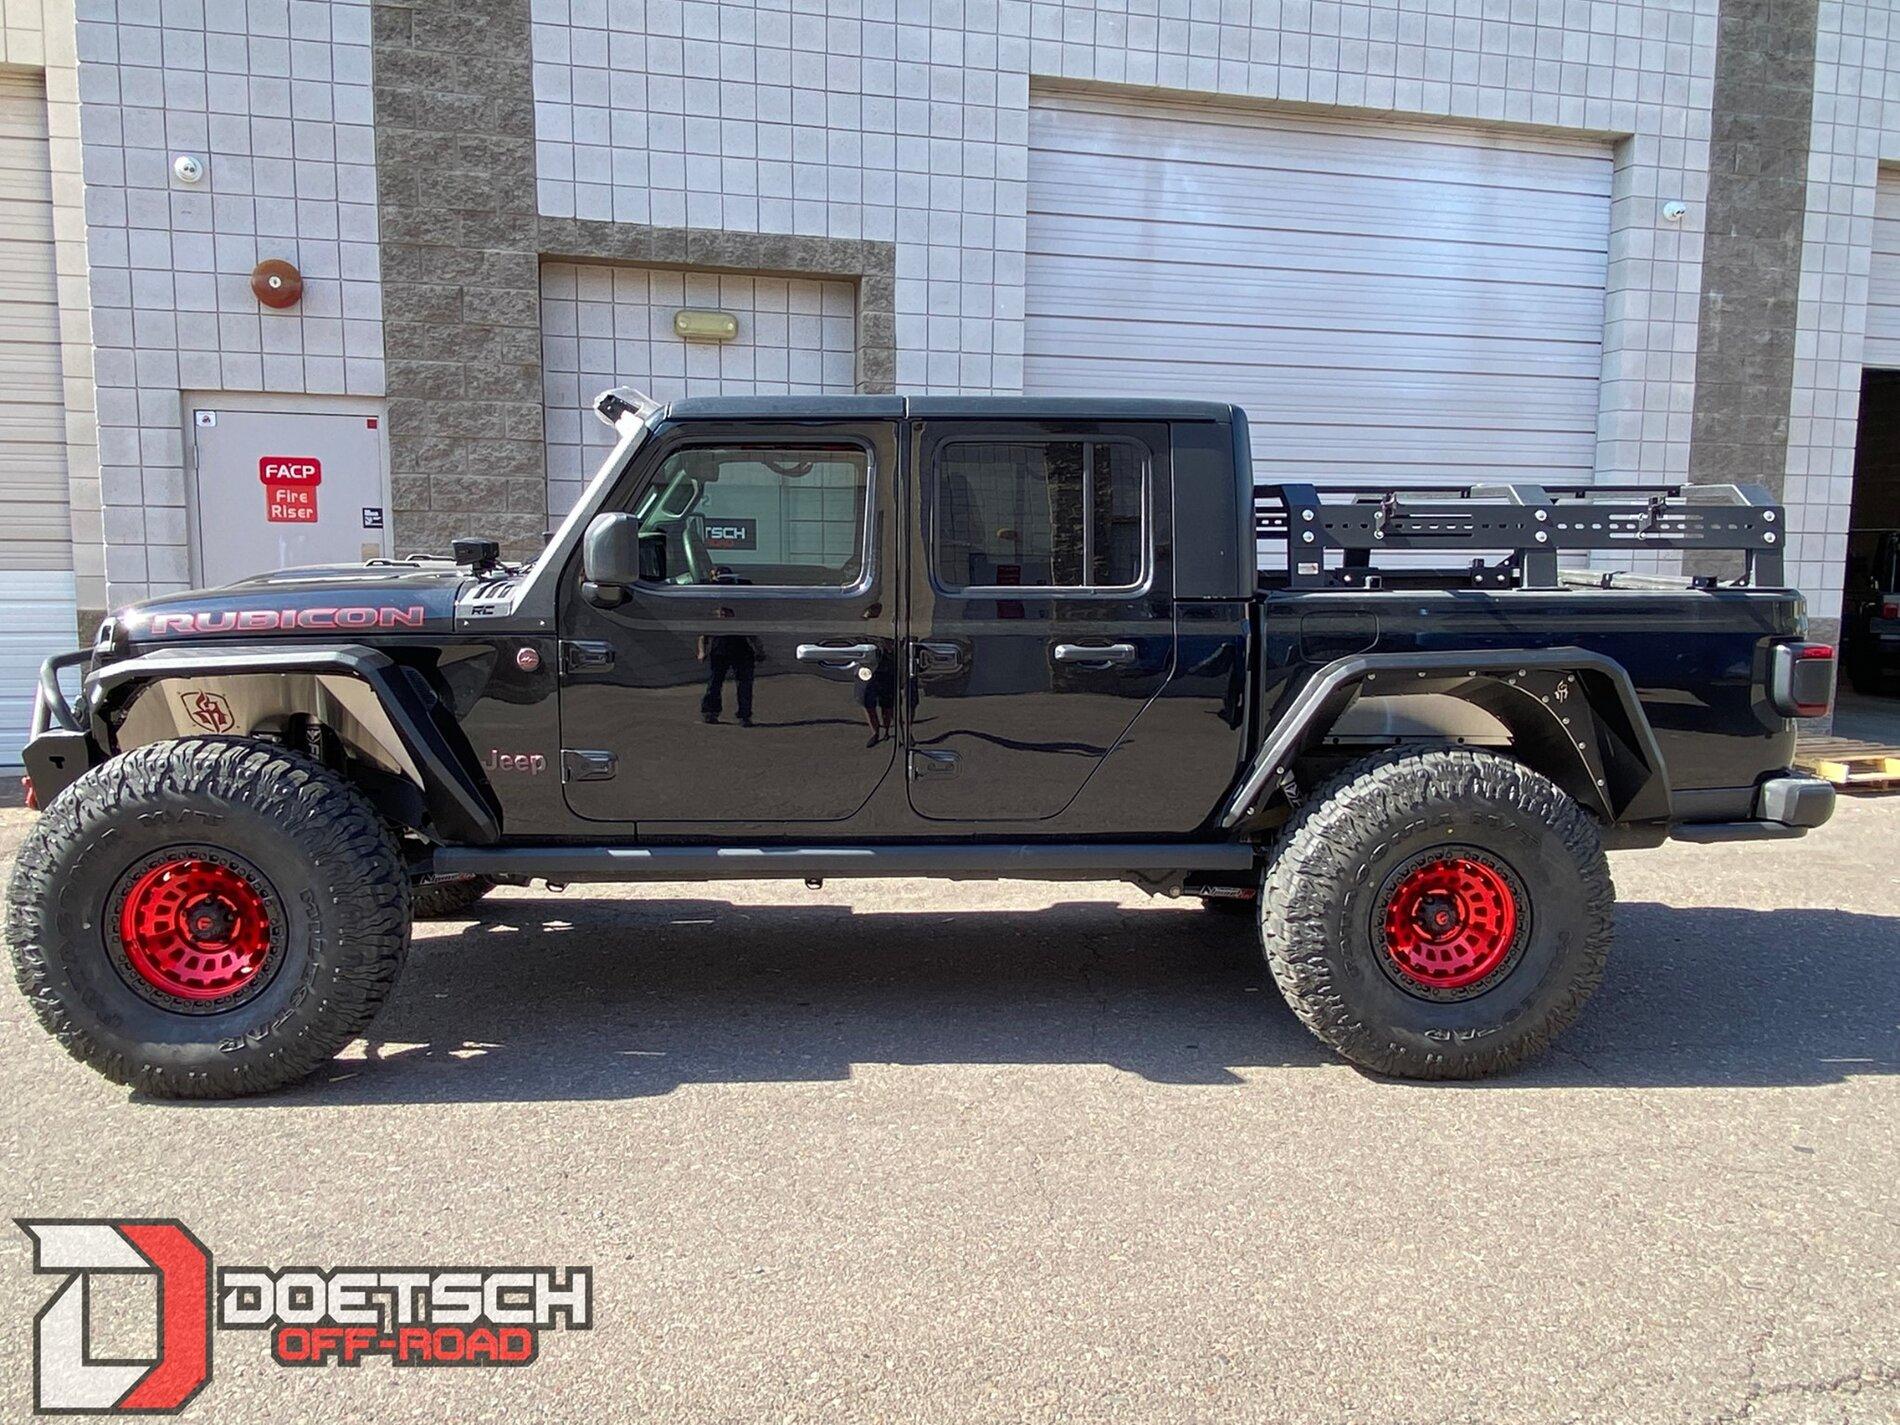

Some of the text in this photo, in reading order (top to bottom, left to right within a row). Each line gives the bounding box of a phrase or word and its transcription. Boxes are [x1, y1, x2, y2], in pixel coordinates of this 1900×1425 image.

[265, 463, 316, 479] FACP
[276, 489, 308, 504] Fire
[271, 504, 314, 519] Riser
[471, 605, 496, 616] RC
[151, 606, 425, 634] RUBICON
[480, 749, 547, 776] Jeep
